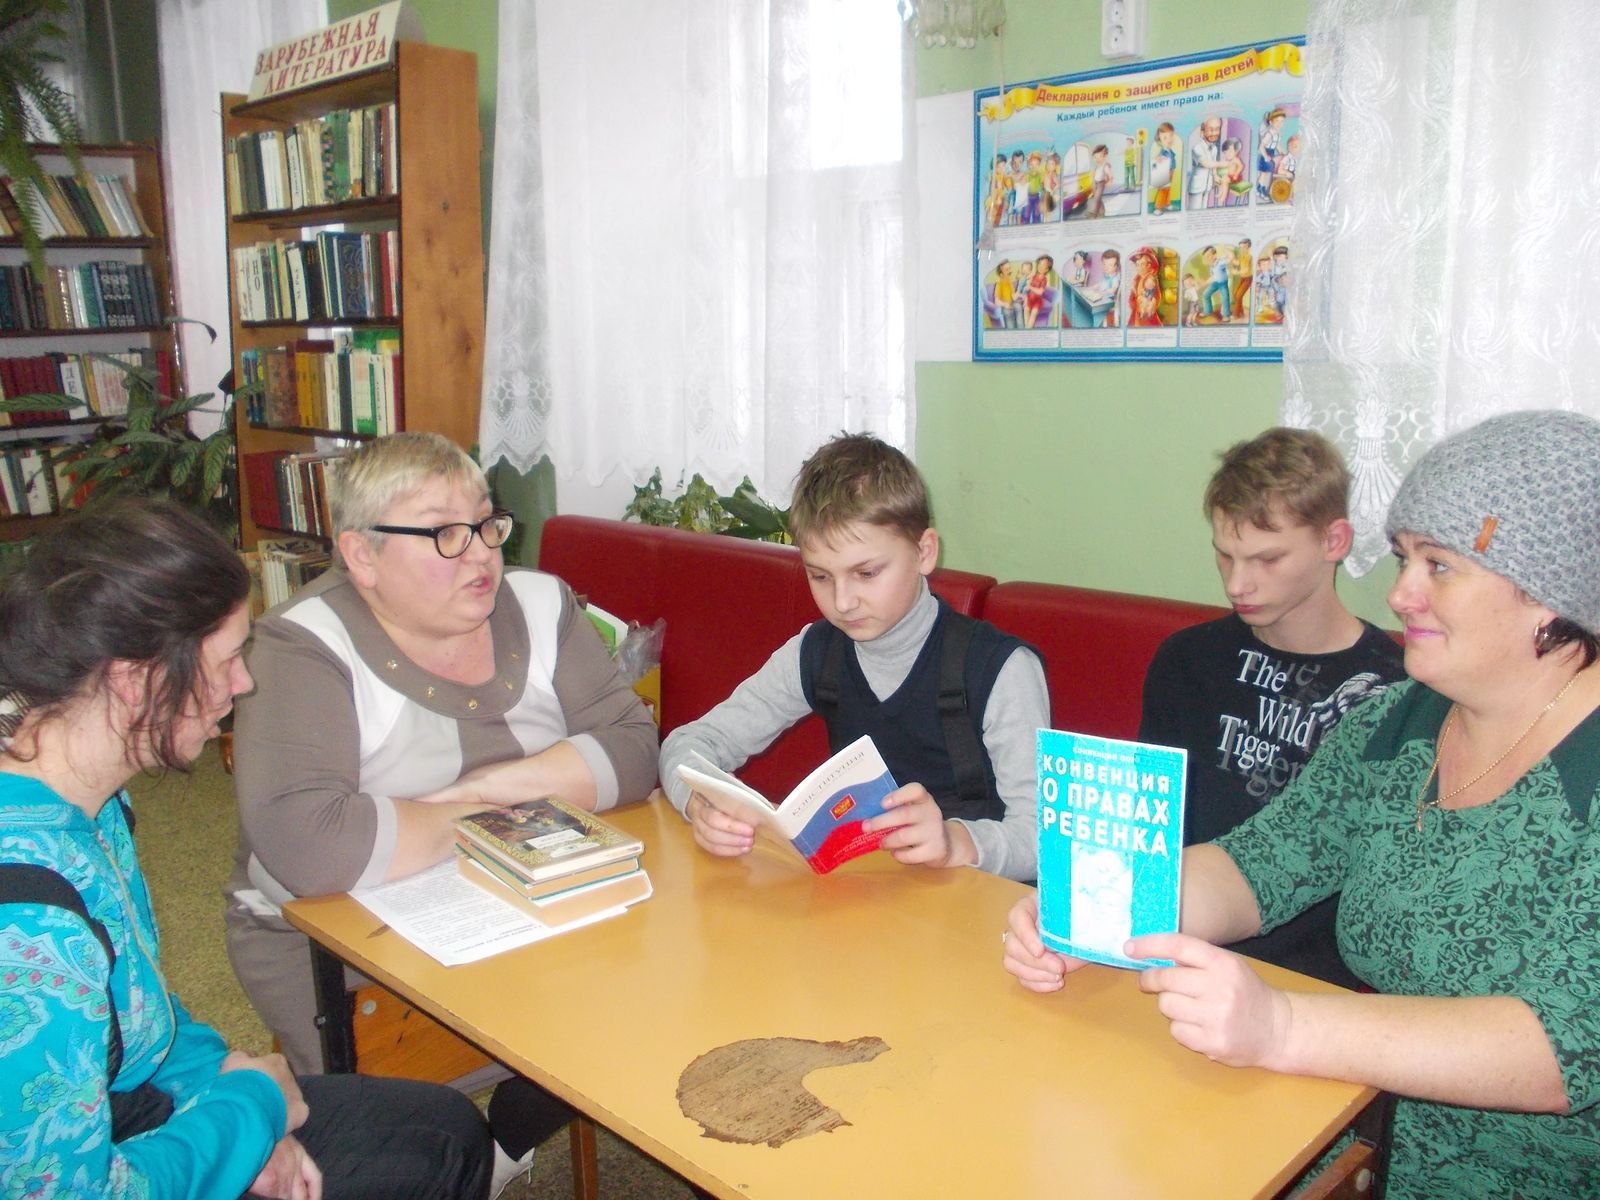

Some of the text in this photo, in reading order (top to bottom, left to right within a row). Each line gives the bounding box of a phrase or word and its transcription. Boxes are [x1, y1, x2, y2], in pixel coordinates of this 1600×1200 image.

[255, 11, 380, 76] ЗАРУБЕЖНАЯ
[263, 36, 387, 96] ЛИТЕРАТУРА
[1036, 57, 1254, 104] Декларация о защите прав детей
[1056, 92, 1224, 122] Каждый ребенок имеет право на:
[1237, 649, 1287, 693] The
[1217, 714, 1280, 769] Tiger
[1259, 695, 1316, 748] Wild
[1042, 754, 1170, 794] КОНВЕНЦИЯ
[1042, 777, 1169, 827] О ПРАВАХ
[1042, 806, 1169, 857] РЕБЕНКА
